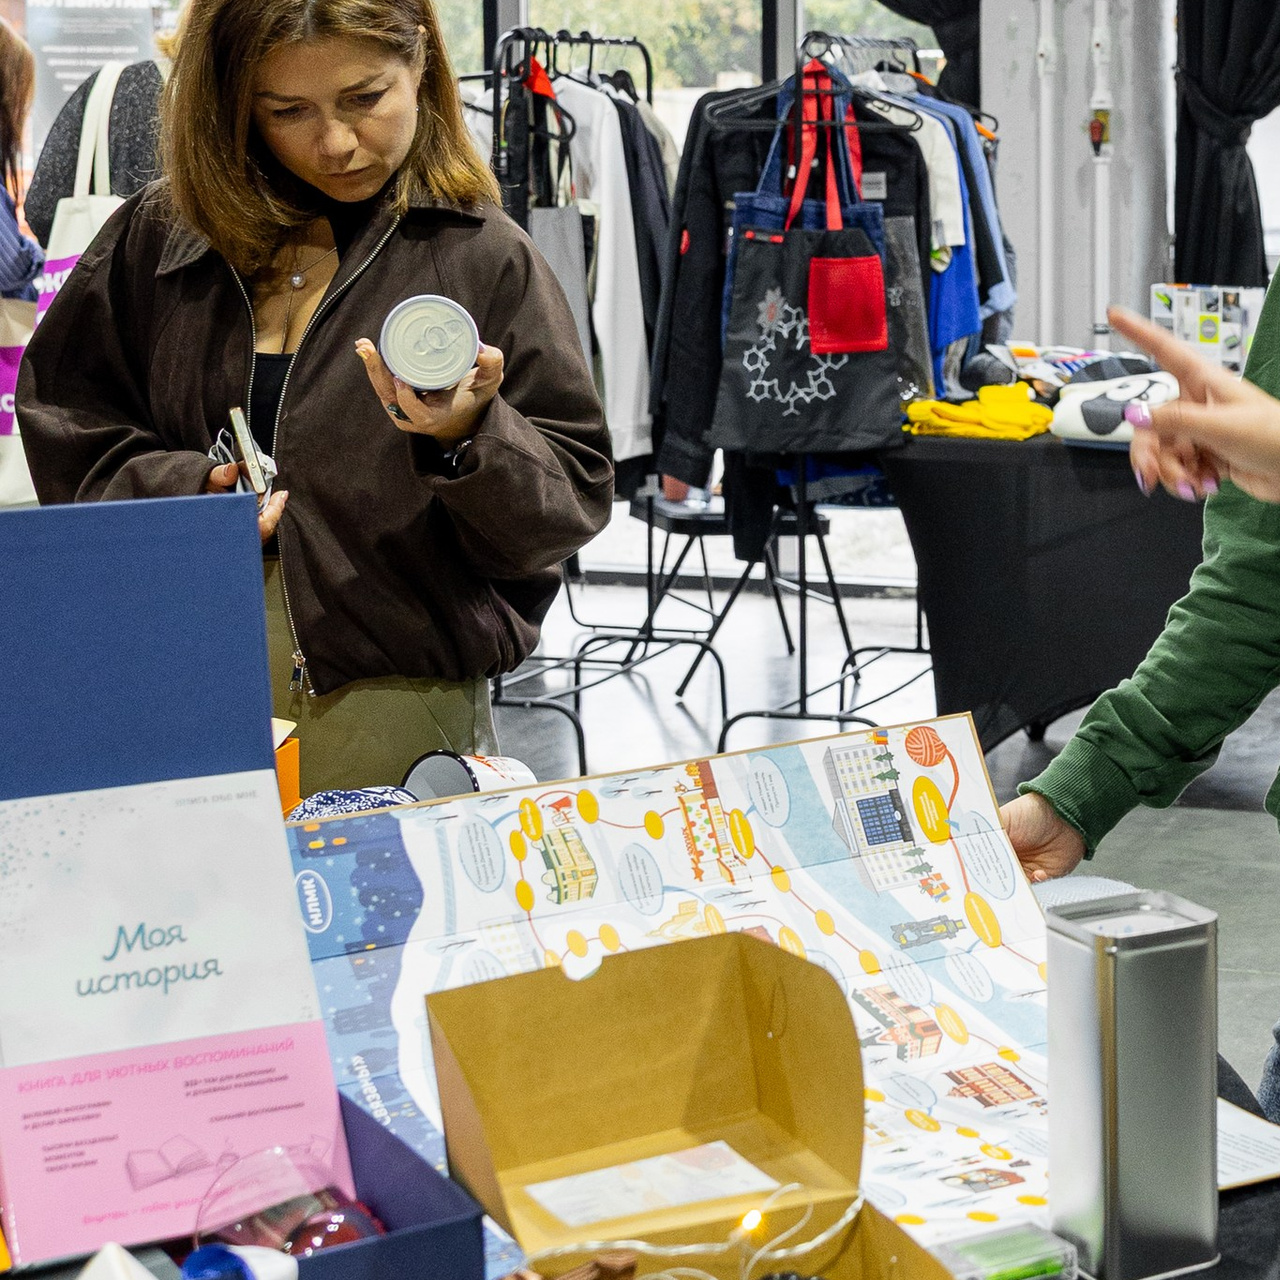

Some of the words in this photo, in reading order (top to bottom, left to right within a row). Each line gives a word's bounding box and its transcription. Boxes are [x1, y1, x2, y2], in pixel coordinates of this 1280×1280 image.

[301, 877, 323, 926] НЛМК
[102, 922, 188, 962] Моя
[75, 958, 223, 996] история
